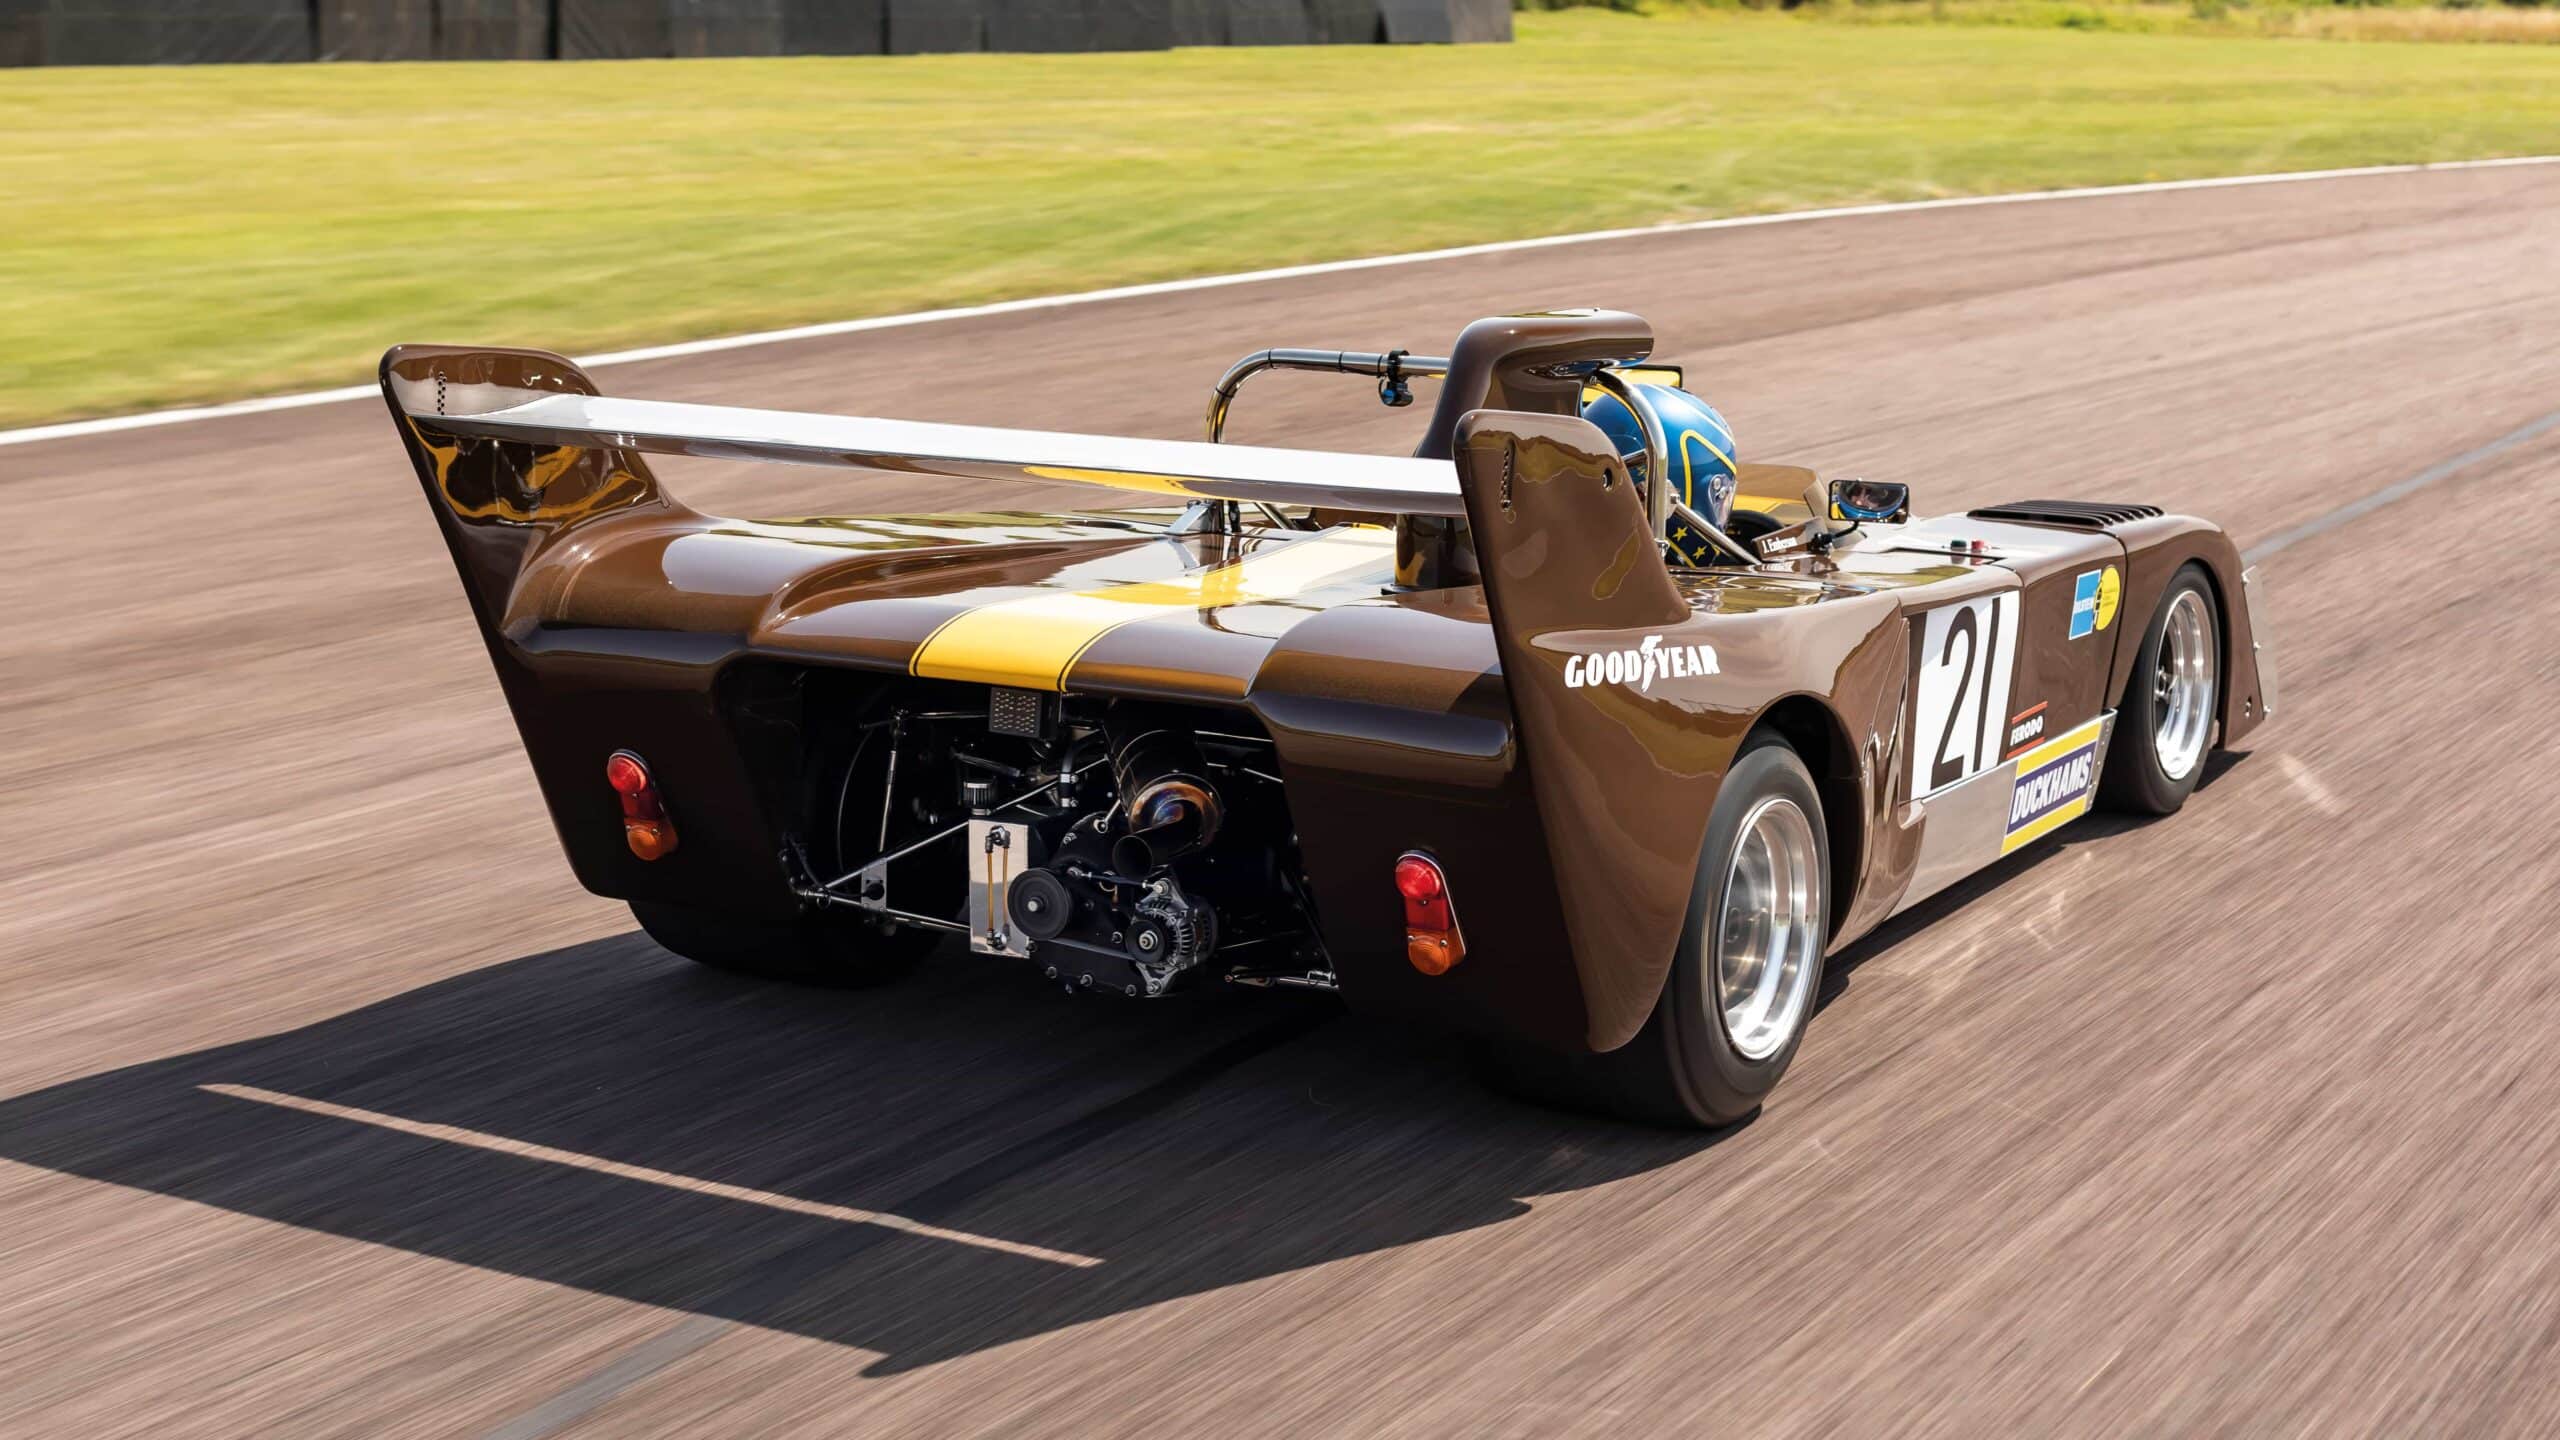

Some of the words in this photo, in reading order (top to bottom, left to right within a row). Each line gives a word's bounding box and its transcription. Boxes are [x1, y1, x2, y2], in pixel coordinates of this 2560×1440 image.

[1564, 635, 1720, 691] GOODYEAR
[1929, 597, 2001, 791] 21
[2010, 751, 2092, 825] DUCKHAMS
